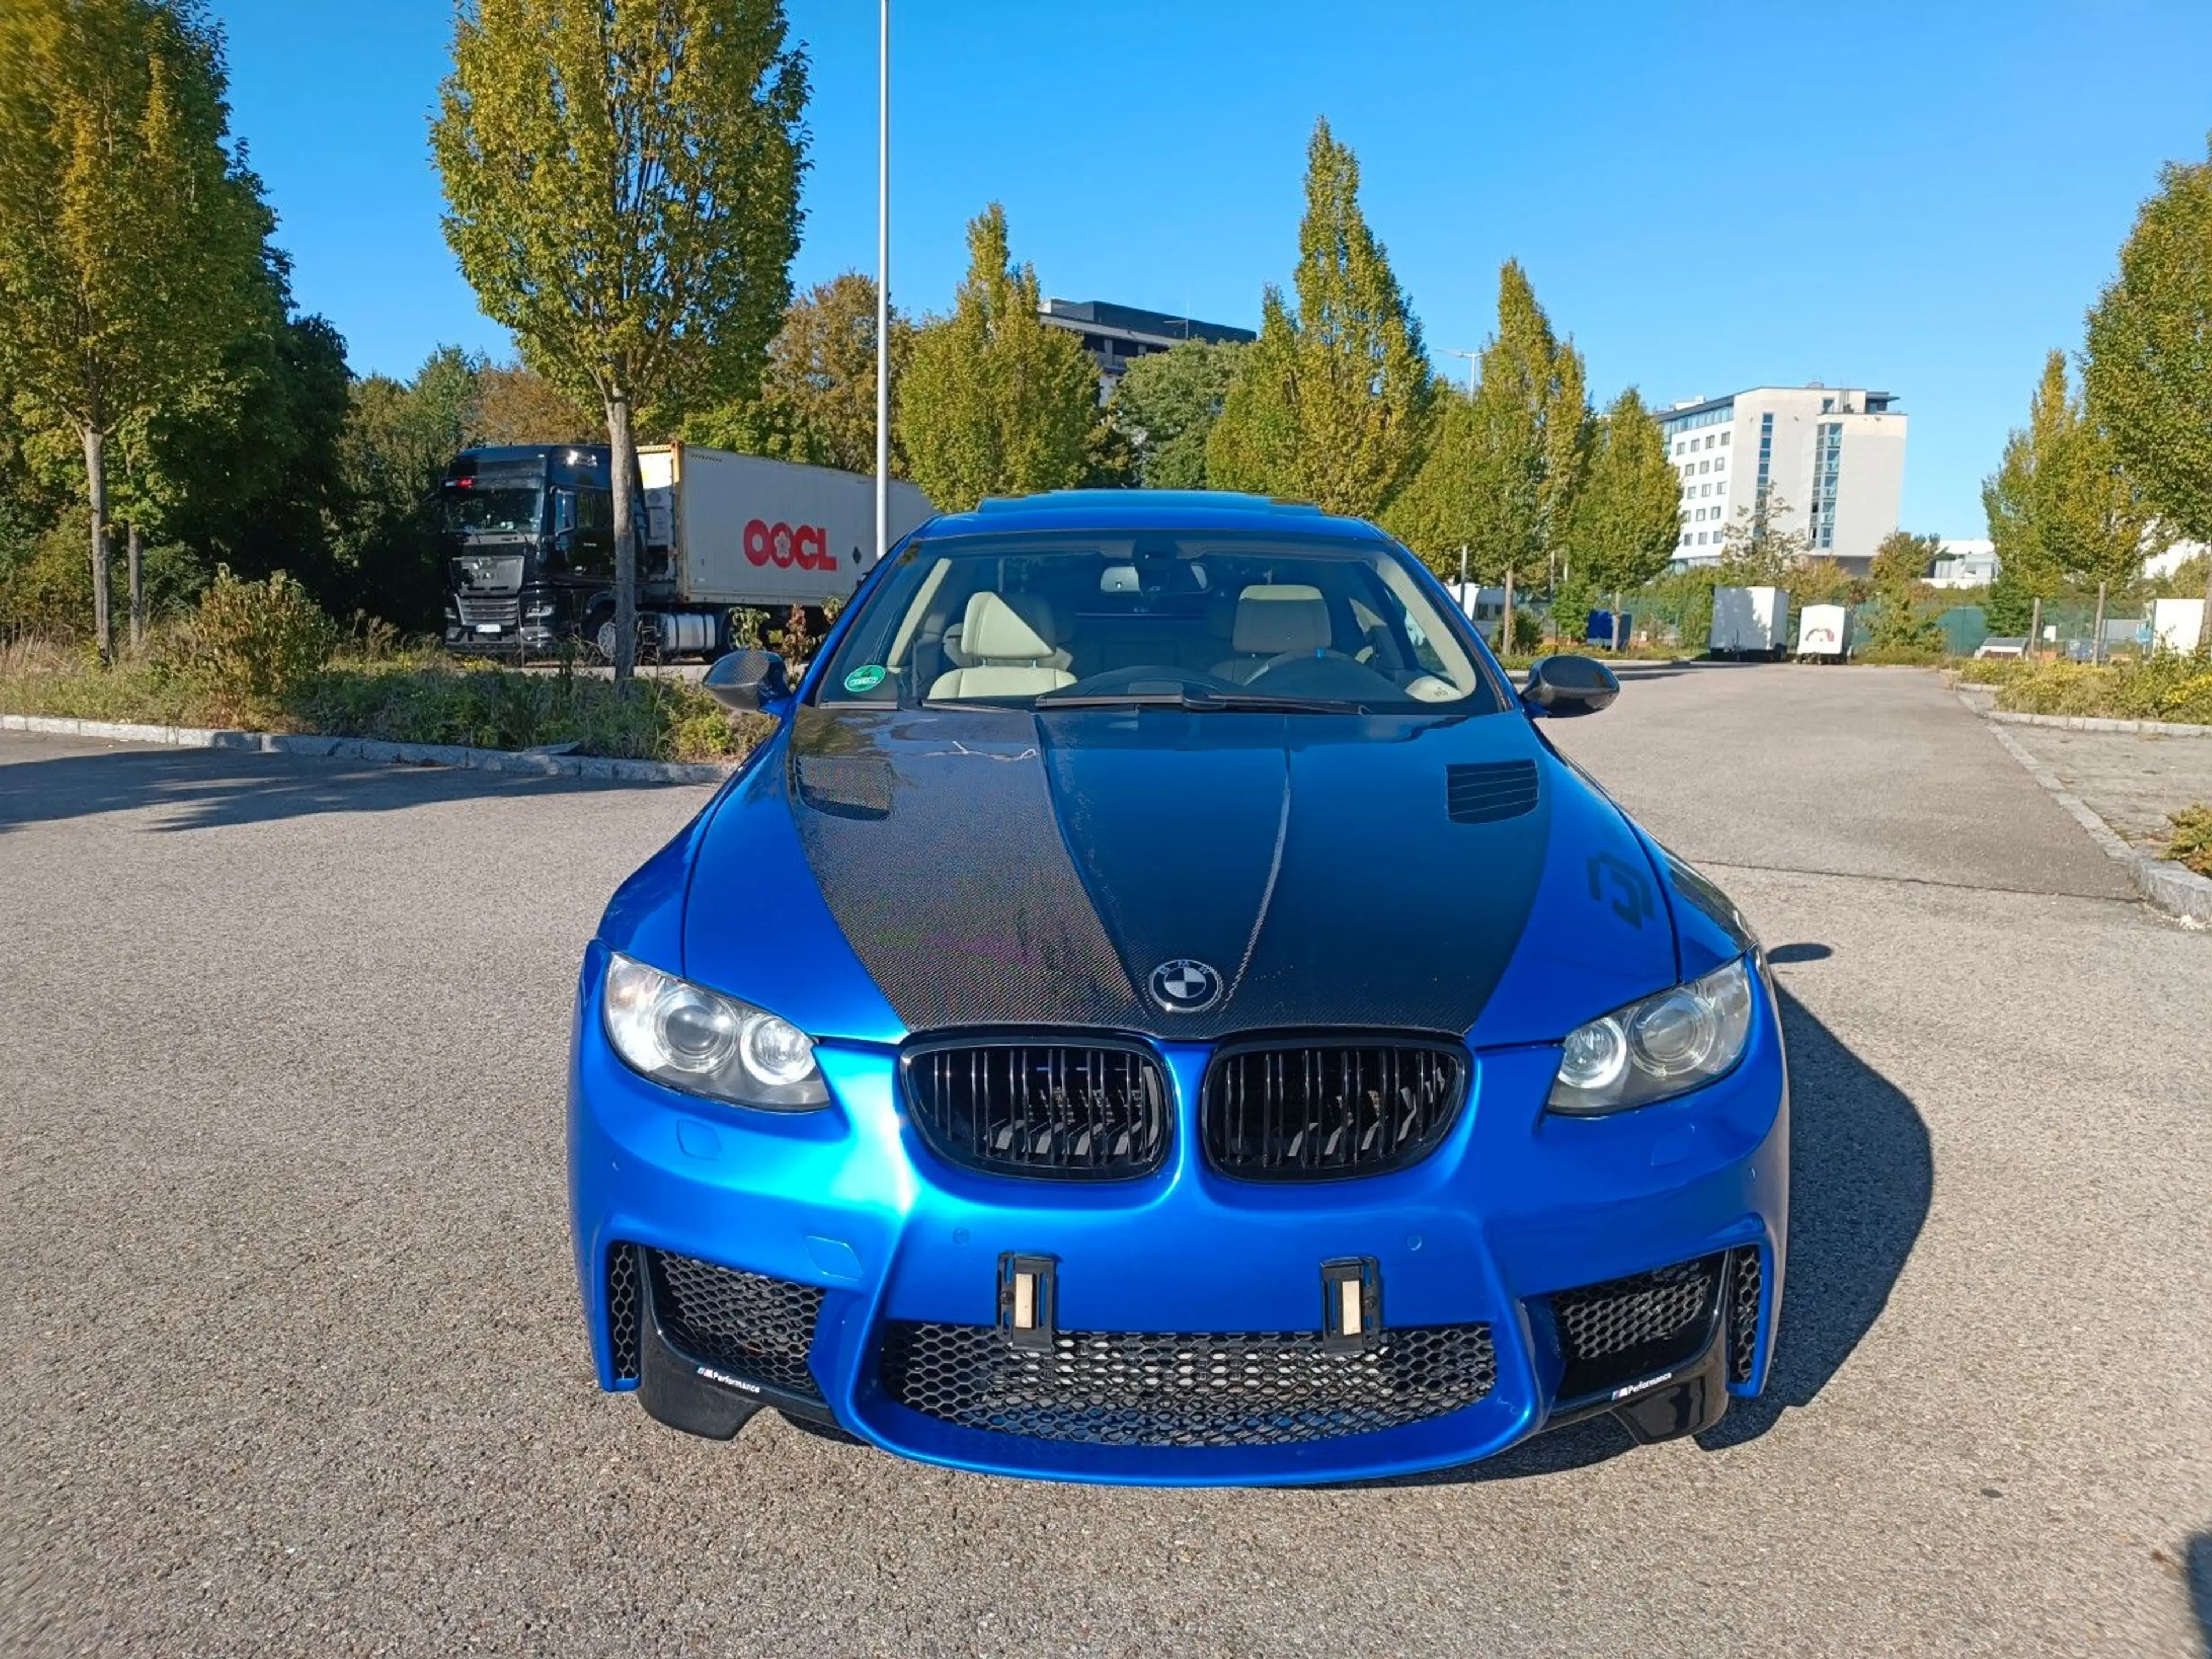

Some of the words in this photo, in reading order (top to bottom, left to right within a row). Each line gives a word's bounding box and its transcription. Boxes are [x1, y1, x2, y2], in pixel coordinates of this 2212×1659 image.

[744, 519, 837, 570] OOCL
[1157, 960, 1210, 974] BMW
[713, 1372, 760, 1393] Performance
[1628, 1372, 1672, 1394] Performance
